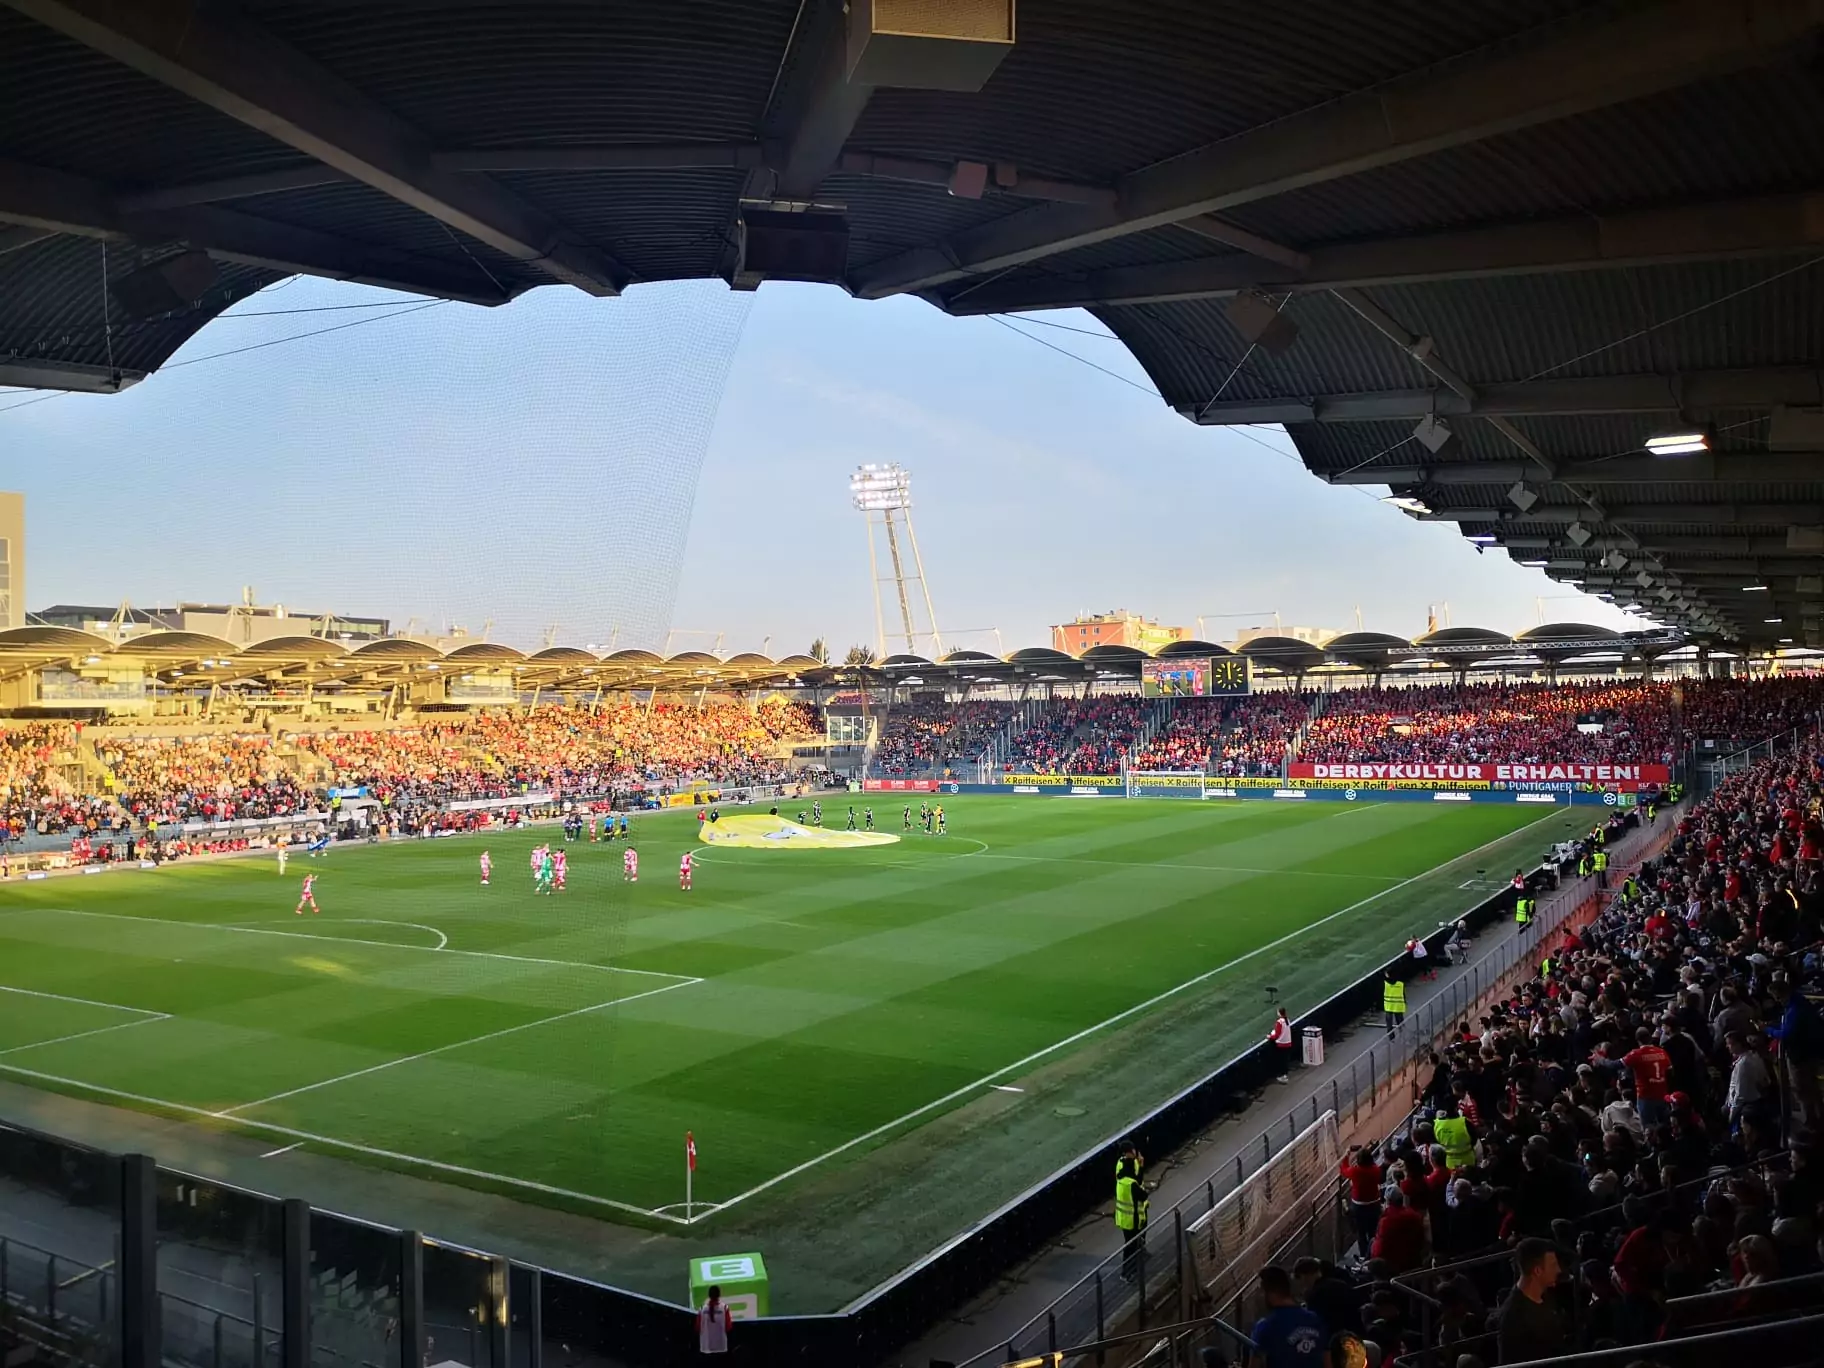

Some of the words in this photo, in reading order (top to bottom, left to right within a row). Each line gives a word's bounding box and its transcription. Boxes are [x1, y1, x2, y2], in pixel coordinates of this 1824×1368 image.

[1314, 765, 1482, 779] DERBYKULTUR
[1497, 765, 1640, 779] ERHALTEN!
[1013, 776, 1053, 785] Raiffeisen
[1235, 779, 1283, 788] Raiffeisen
[1300, 780, 1350, 789] Raiffeisen
[1364, 780, 1418, 790] Raiffisen
